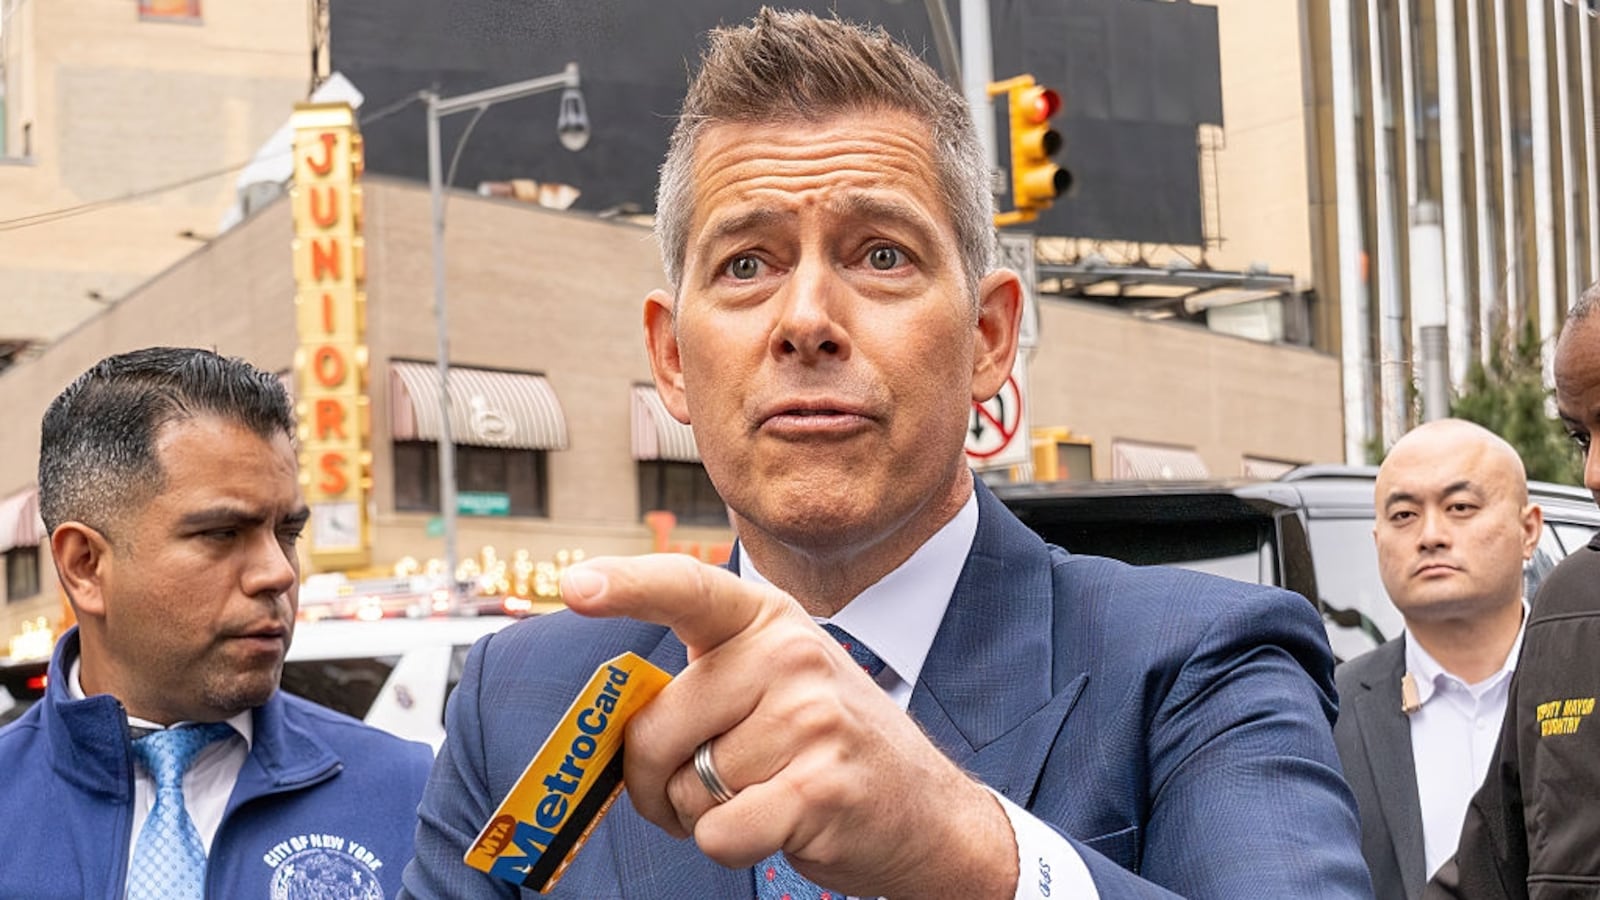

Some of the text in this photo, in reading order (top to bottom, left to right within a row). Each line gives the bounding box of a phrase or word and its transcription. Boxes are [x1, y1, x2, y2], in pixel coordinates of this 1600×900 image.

[307, 133, 348, 496] JUNIORS
[1563, 698, 1595, 716] MAYOR
[488, 665, 631, 885] MetroCard
[263, 833, 383, 871] CITY OF NEW YORK
[478, 821, 512, 859] MTA
